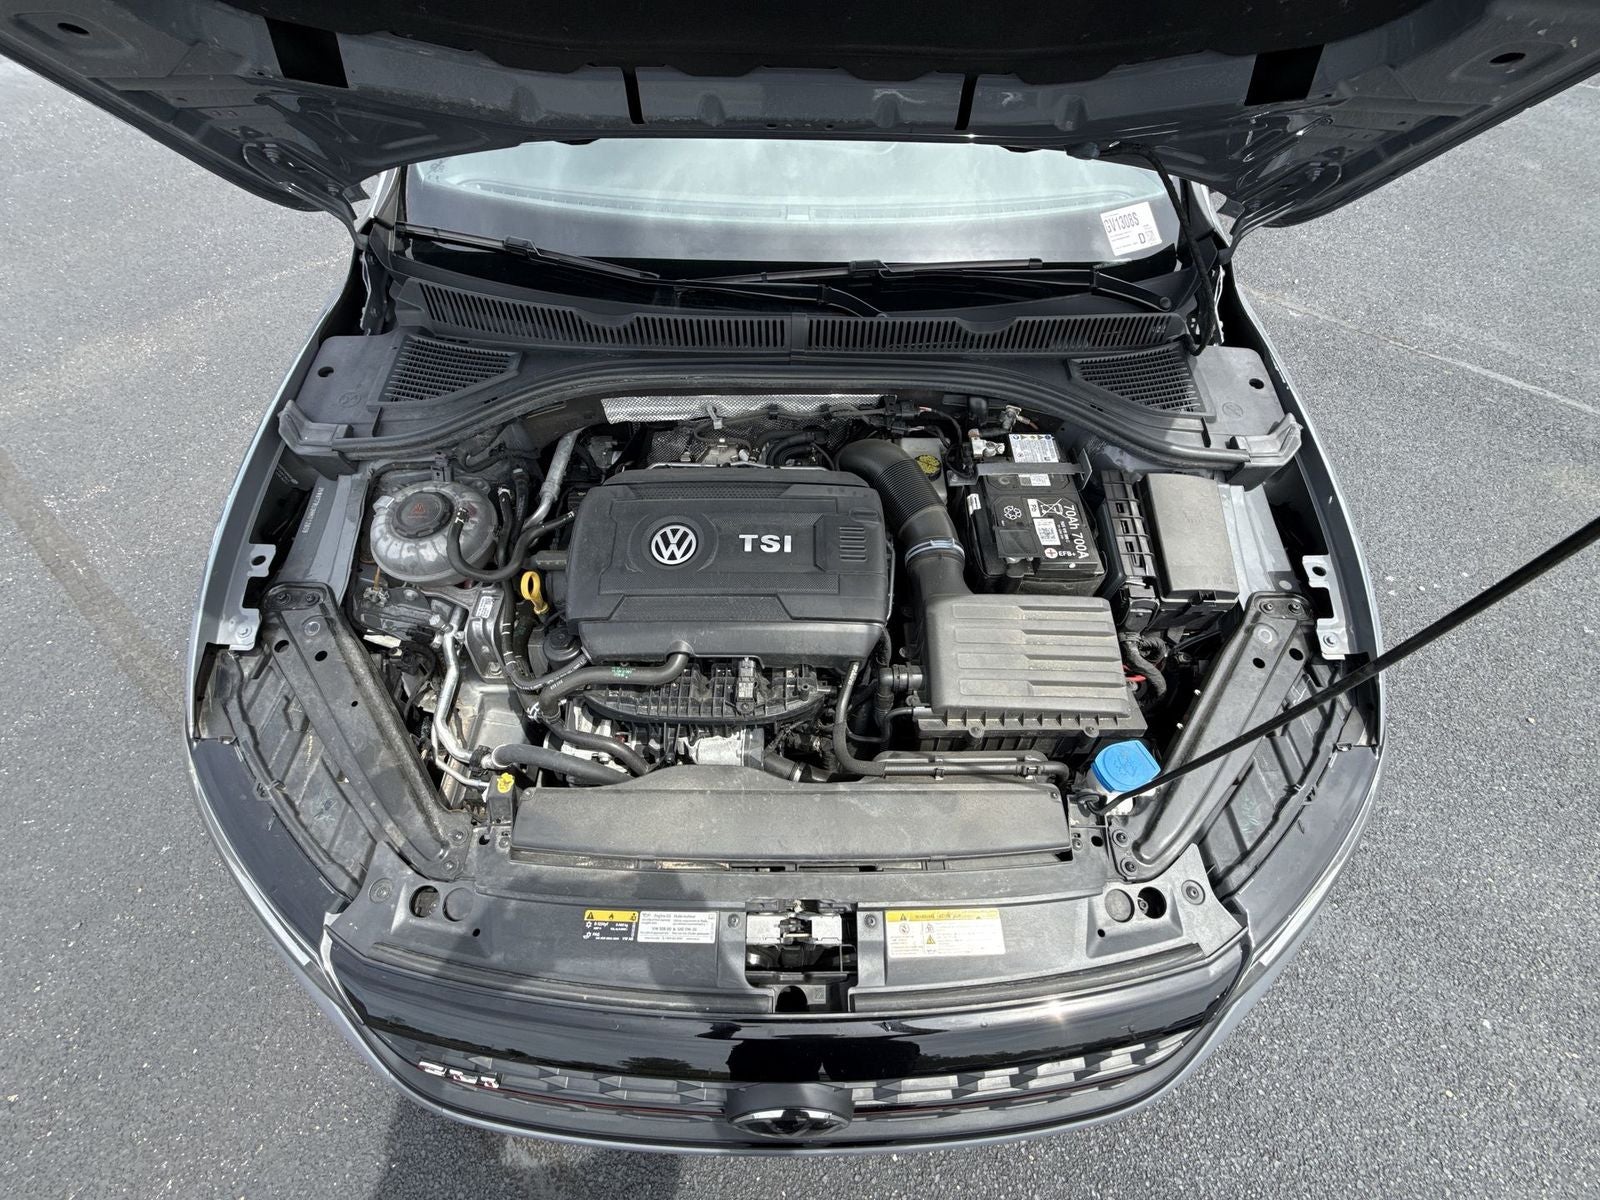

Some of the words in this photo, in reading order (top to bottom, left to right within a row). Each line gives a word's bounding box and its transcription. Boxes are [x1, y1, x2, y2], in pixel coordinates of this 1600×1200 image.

[1104, 212, 1139, 233] GV1308S
[1138, 232, 1146, 244] D
[1064, 504, 1080, 530] 70Ah
[738, 534, 792, 553] TSI
[1071, 532, 1090, 559] 700A
